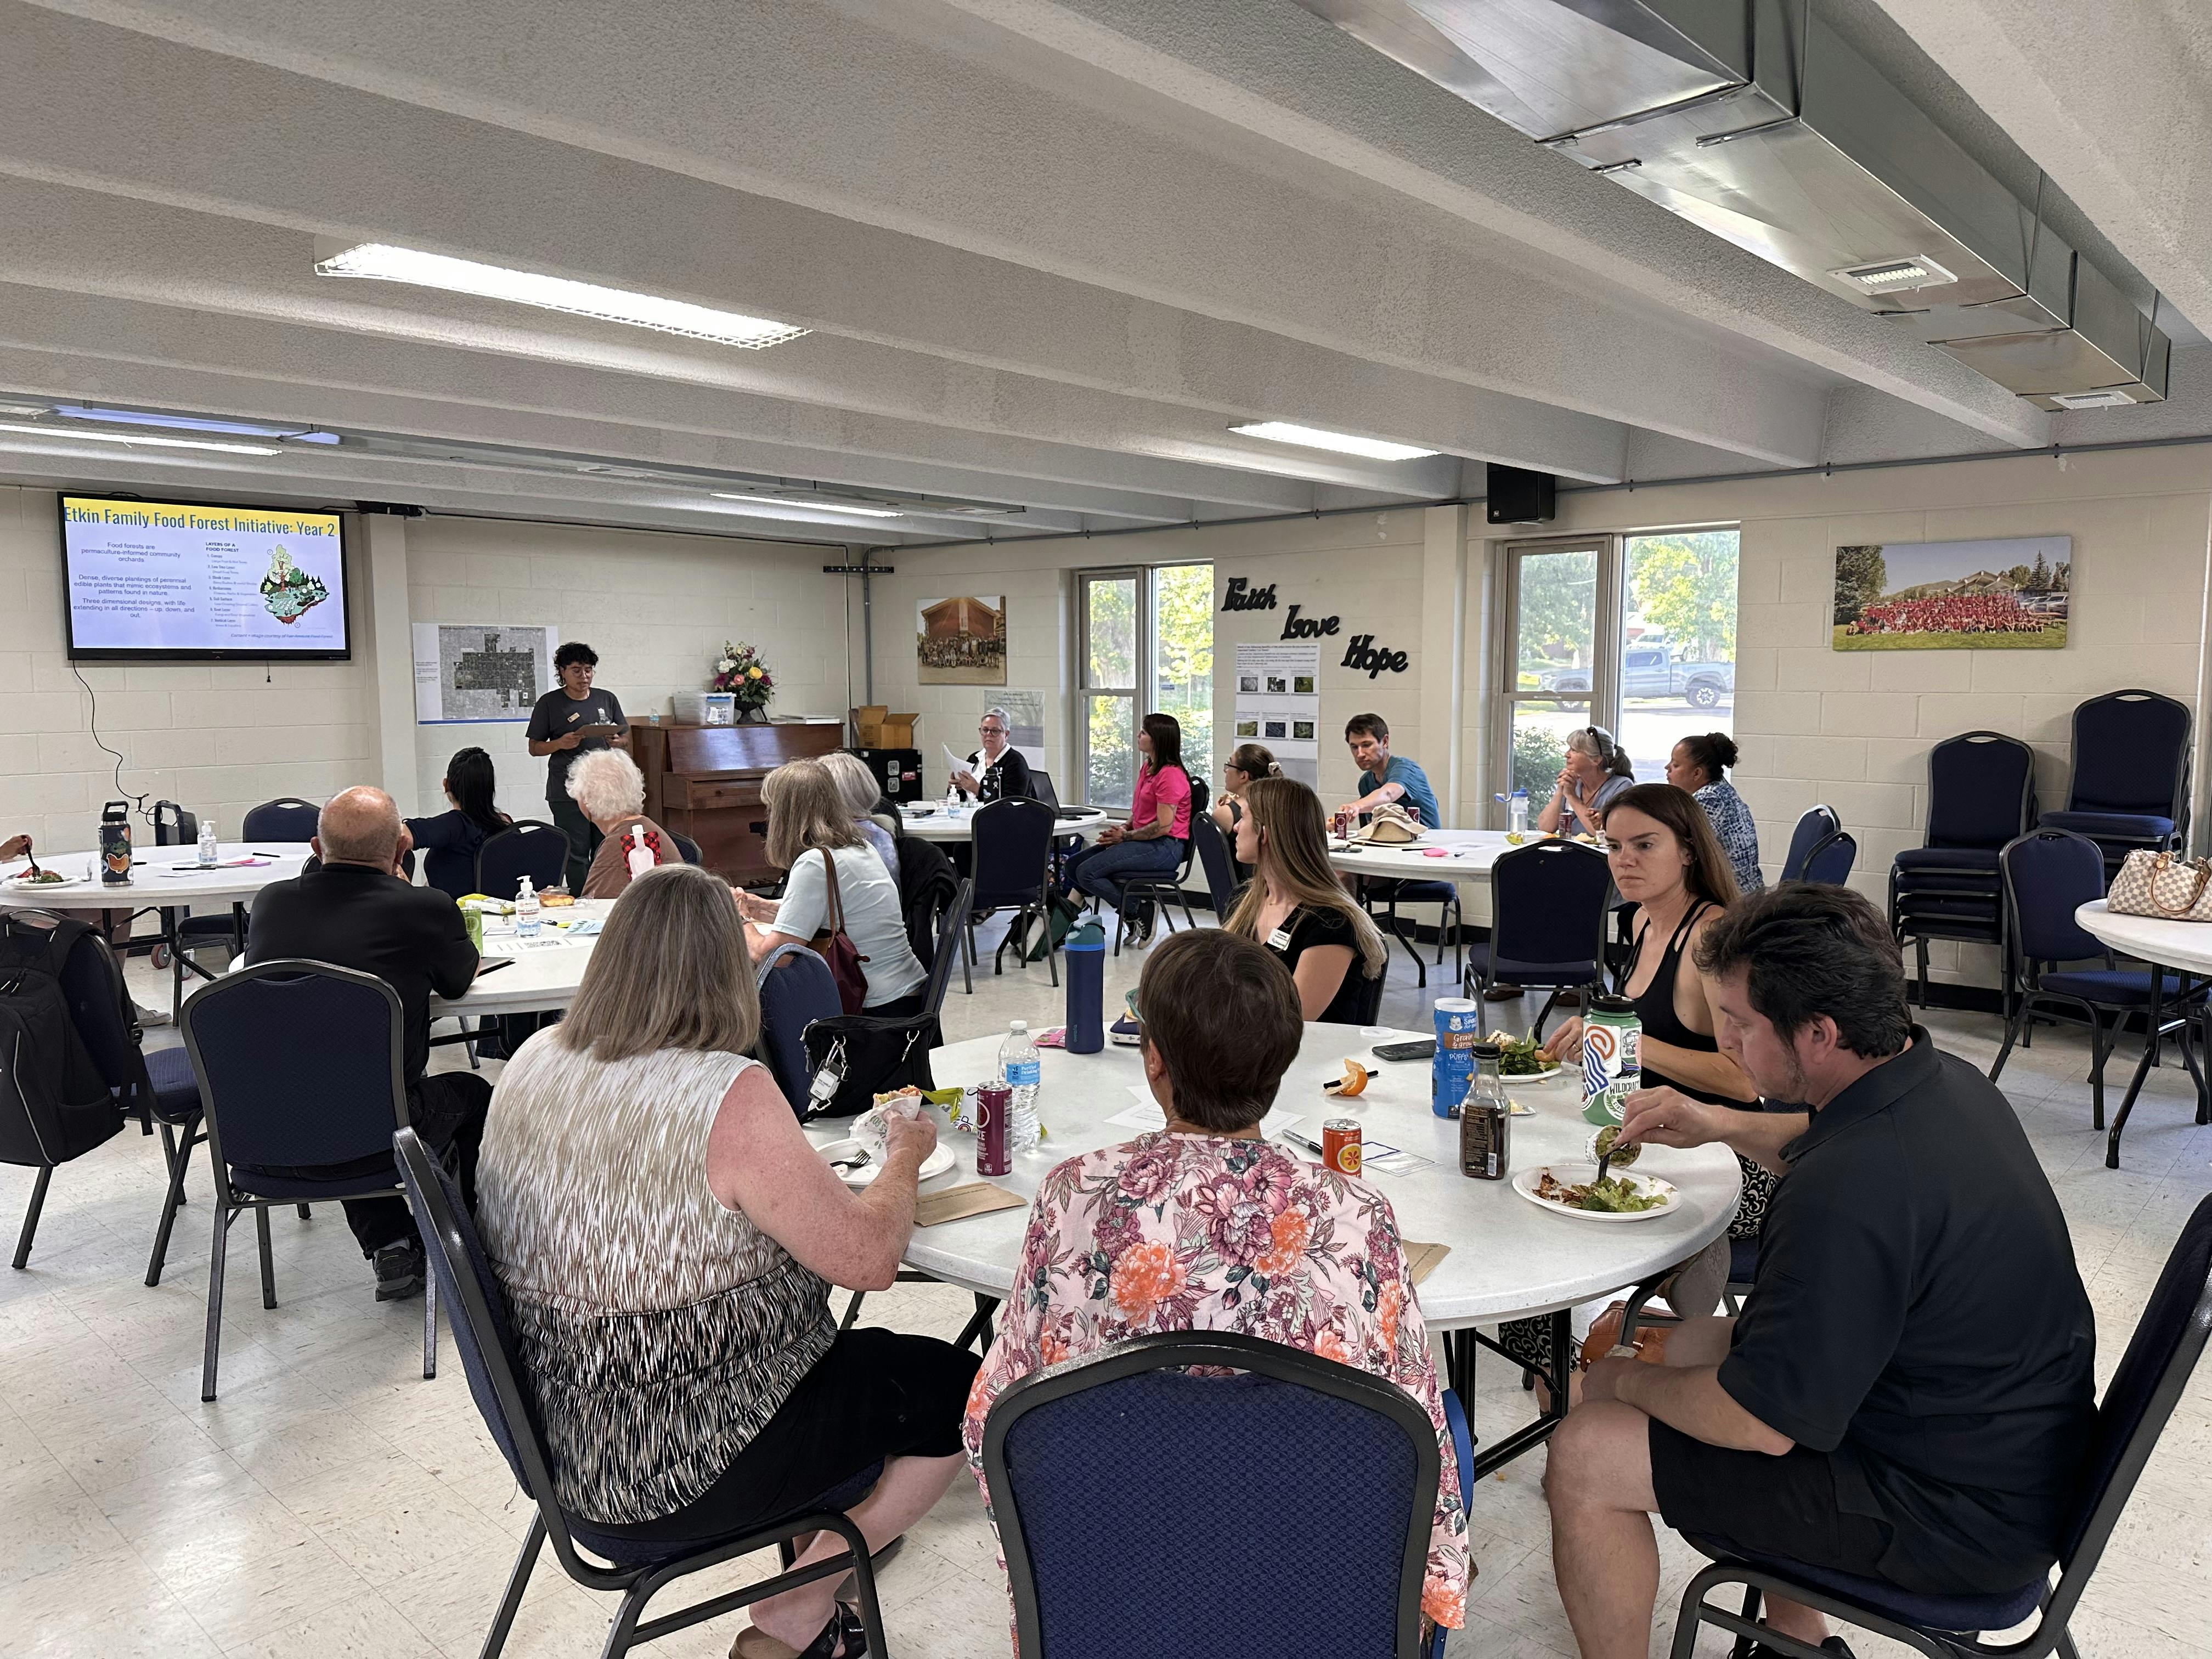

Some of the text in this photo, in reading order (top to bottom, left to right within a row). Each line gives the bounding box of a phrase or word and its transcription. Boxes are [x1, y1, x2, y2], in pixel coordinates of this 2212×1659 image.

[64, 506, 335, 537] Etkin Family Food Forest Initiative: Year 2
[1221, 577, 1277, 612] Faith
[1280, 605, 1340, 640] Love
[1340, 634, 1409, 679] Hope
